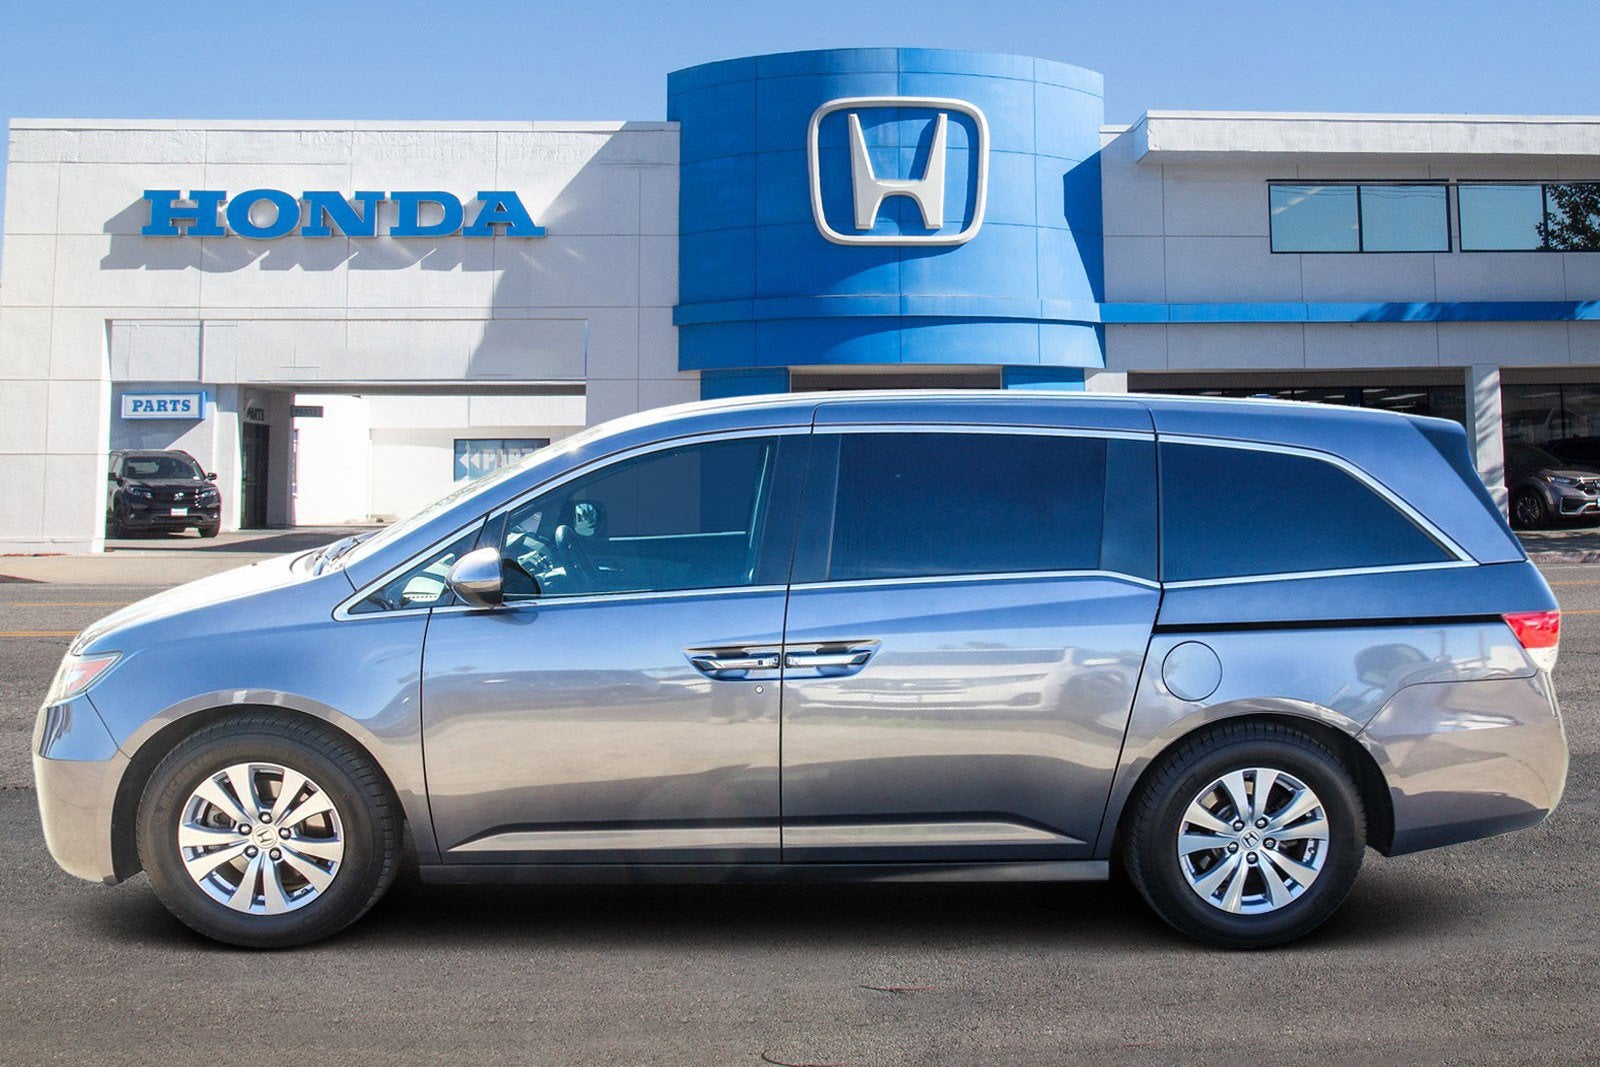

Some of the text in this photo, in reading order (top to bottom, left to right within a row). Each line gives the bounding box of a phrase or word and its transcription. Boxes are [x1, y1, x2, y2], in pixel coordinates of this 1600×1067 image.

[141, 189, 548, 239] HONDA
[132, 399, 191, 412] PARTS
[483, 448, 541, 470] PART
